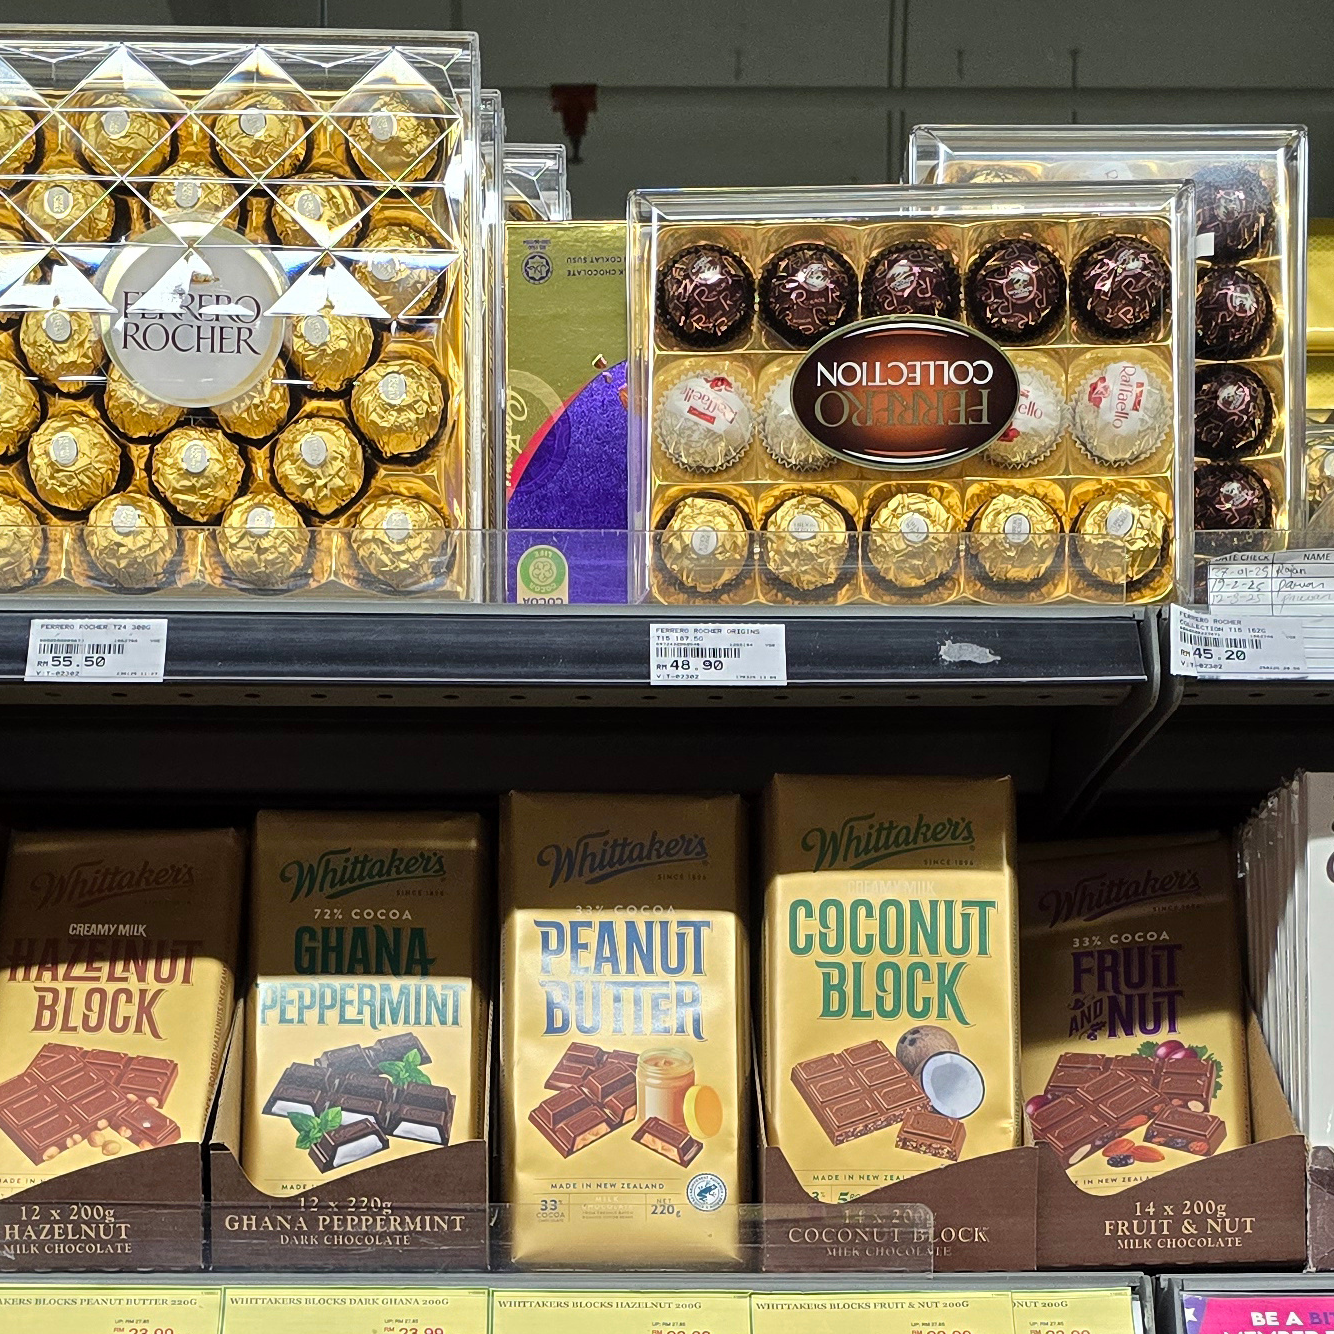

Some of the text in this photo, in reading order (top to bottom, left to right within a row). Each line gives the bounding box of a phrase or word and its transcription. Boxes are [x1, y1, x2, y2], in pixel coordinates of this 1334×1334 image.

[121, 323, 262, 355] ROCHER
[817, 360, 994, 388] COLLECTION
[815, 388, 993, 427] FERRERO
[726, 628, 760, 636] ORIGINS
[1192, 648, 1246, 661] 45.20
[51, 655, 106, 668] 55.50
[669, 660, 724, 672] 48.90
[293, 924, 437, 978] GHANA
[534, 918, 713, 977] PEANUT
[788, 897, 997, 959] COCONUT
[816, 960, 976, 1026] BLOCK
[1068, 945, 1184, 995] FRUIT
[33, 987, 164, 1040] BLOCK
[259, 981, 467, 1030] PEPPERMINT
[539, 979, 708, 1042] BUTTER
[1105, 991, 1185, 1039] NUT
[550, 1181, 665, 1190] MADE IN NEW ZEALAND
